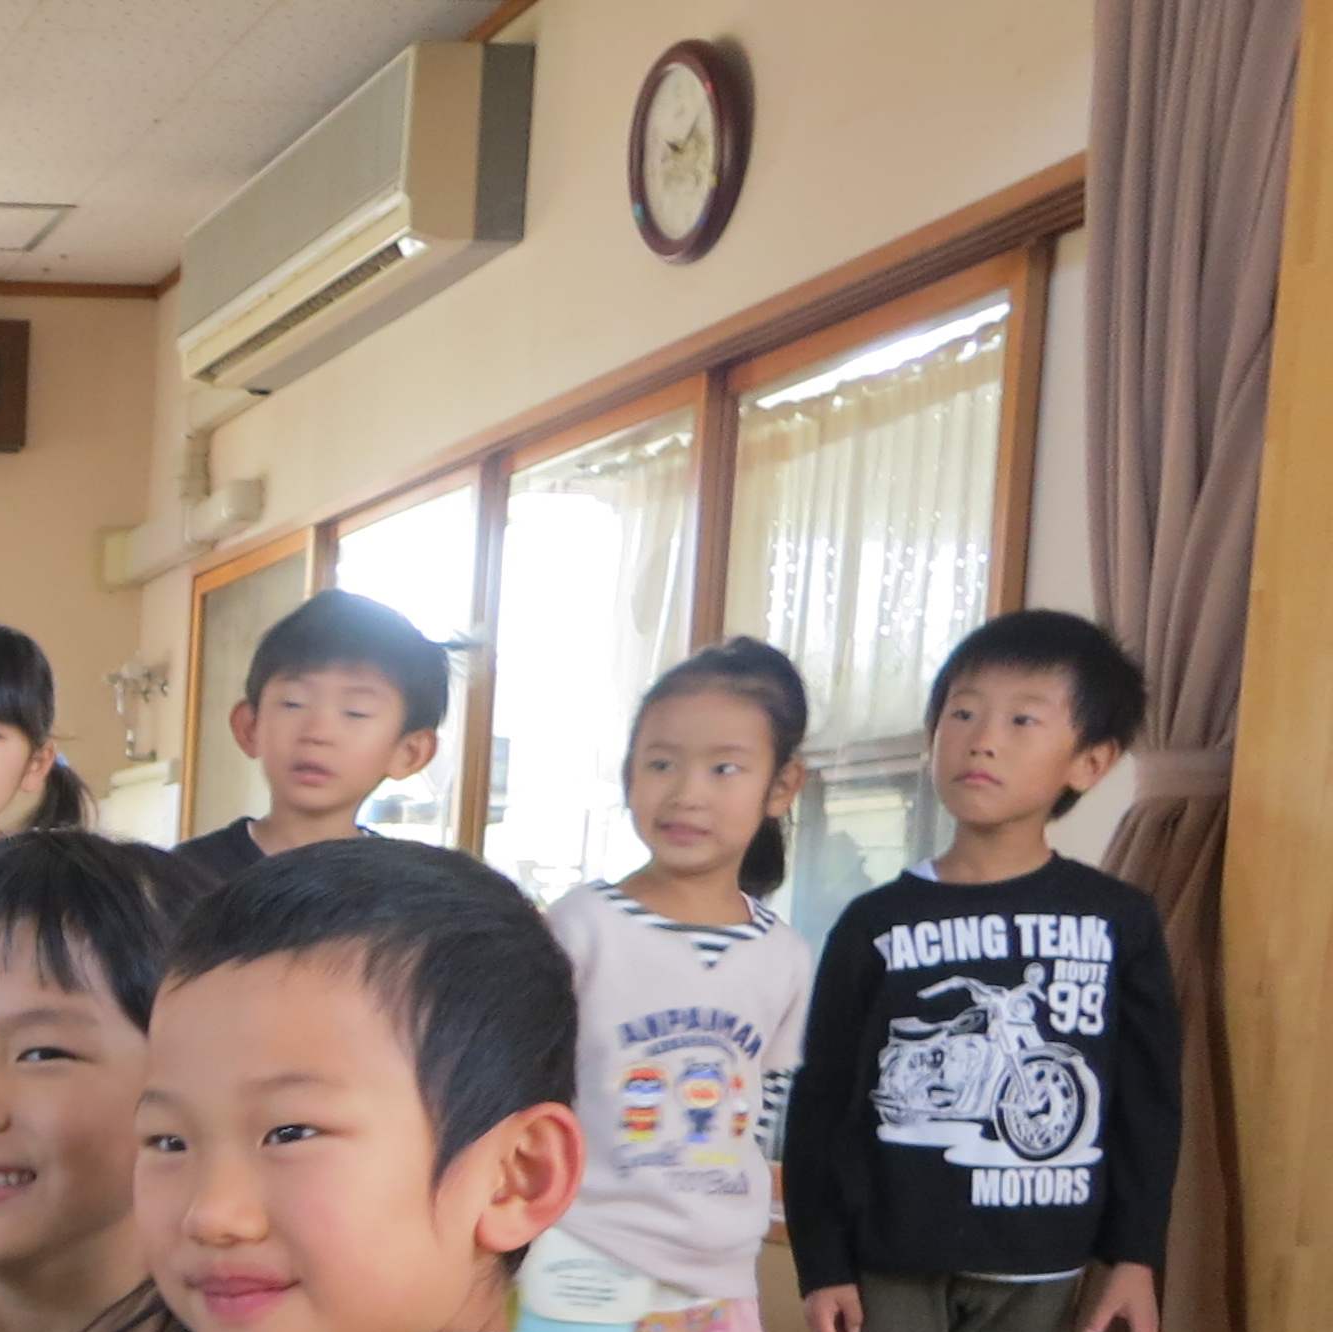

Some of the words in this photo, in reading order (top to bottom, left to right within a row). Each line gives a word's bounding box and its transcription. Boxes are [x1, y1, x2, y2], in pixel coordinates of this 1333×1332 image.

[1013, 912, 1113, 962] TEAM
[1047, 981, 1107, 1035] 99
[970, 1167, 1091, 1207] MOTORS
